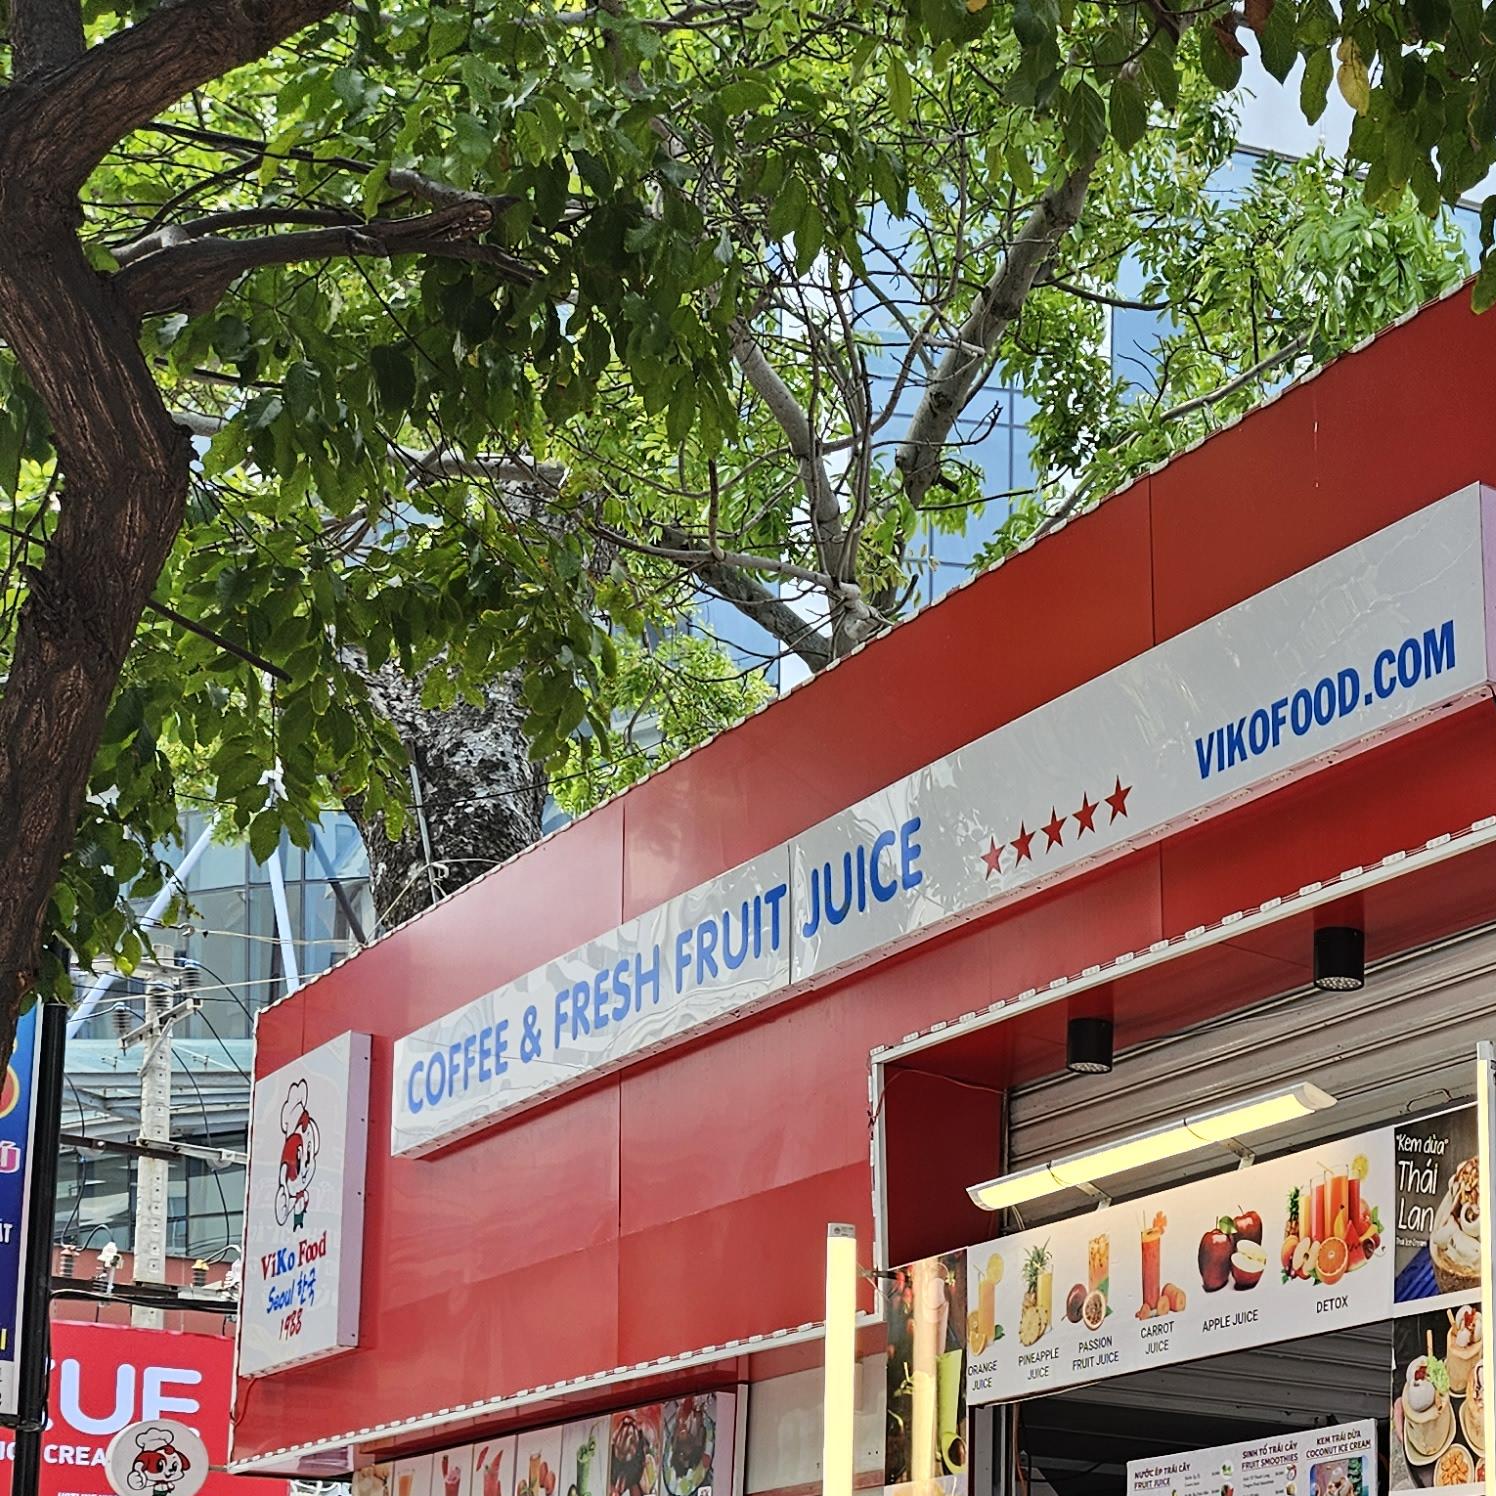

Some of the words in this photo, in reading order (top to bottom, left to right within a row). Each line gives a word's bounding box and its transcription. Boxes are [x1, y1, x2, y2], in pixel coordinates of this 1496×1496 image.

[1195, 619, 1456, 780] VIKOFOOD.COM
[407, 1018, 509, 1114] COFFEE
[519, 1003, 542, 1063] &
[553, 944, 661, 1049] FRESH
[675, 883, 788, 994] FRUIT
[802, 816, 924, 938] JUICE
[1398, 1158, 1439, 1195] Thái
[1398, 1197, 1434, 1232] Lan
[261, 1247, 296, 1281] ViKo
[298, 1230, 328, 1268] Food
[266, 1279, 296, 1314] Seoul
[1316, 1295, 1349, 1314] DETOX
[1140, 1321, 1175, 1339] CARROT
[1202, 1314, 1231, 1333] APPLE
[1232, 1309, 1259, 1328] JUICE
[1078, 1335, 1113, 1354] PASSION
[1145, 1339, 1169, 1355] JUICE
[1018, 1347, 1059, 1367] PINEAPPLE
[1072, 1355, 1095, 1372] FRUIT
[1096, 1350, 1120, 1367] JUICE
[968, 1359, 998, 1377] ORANGE
[1027, 1365, 1050, 1381] JUICE
[972, 1376, 993, 1391] JUICE
[1306, 1445, 1337, 1459] COCONUT
